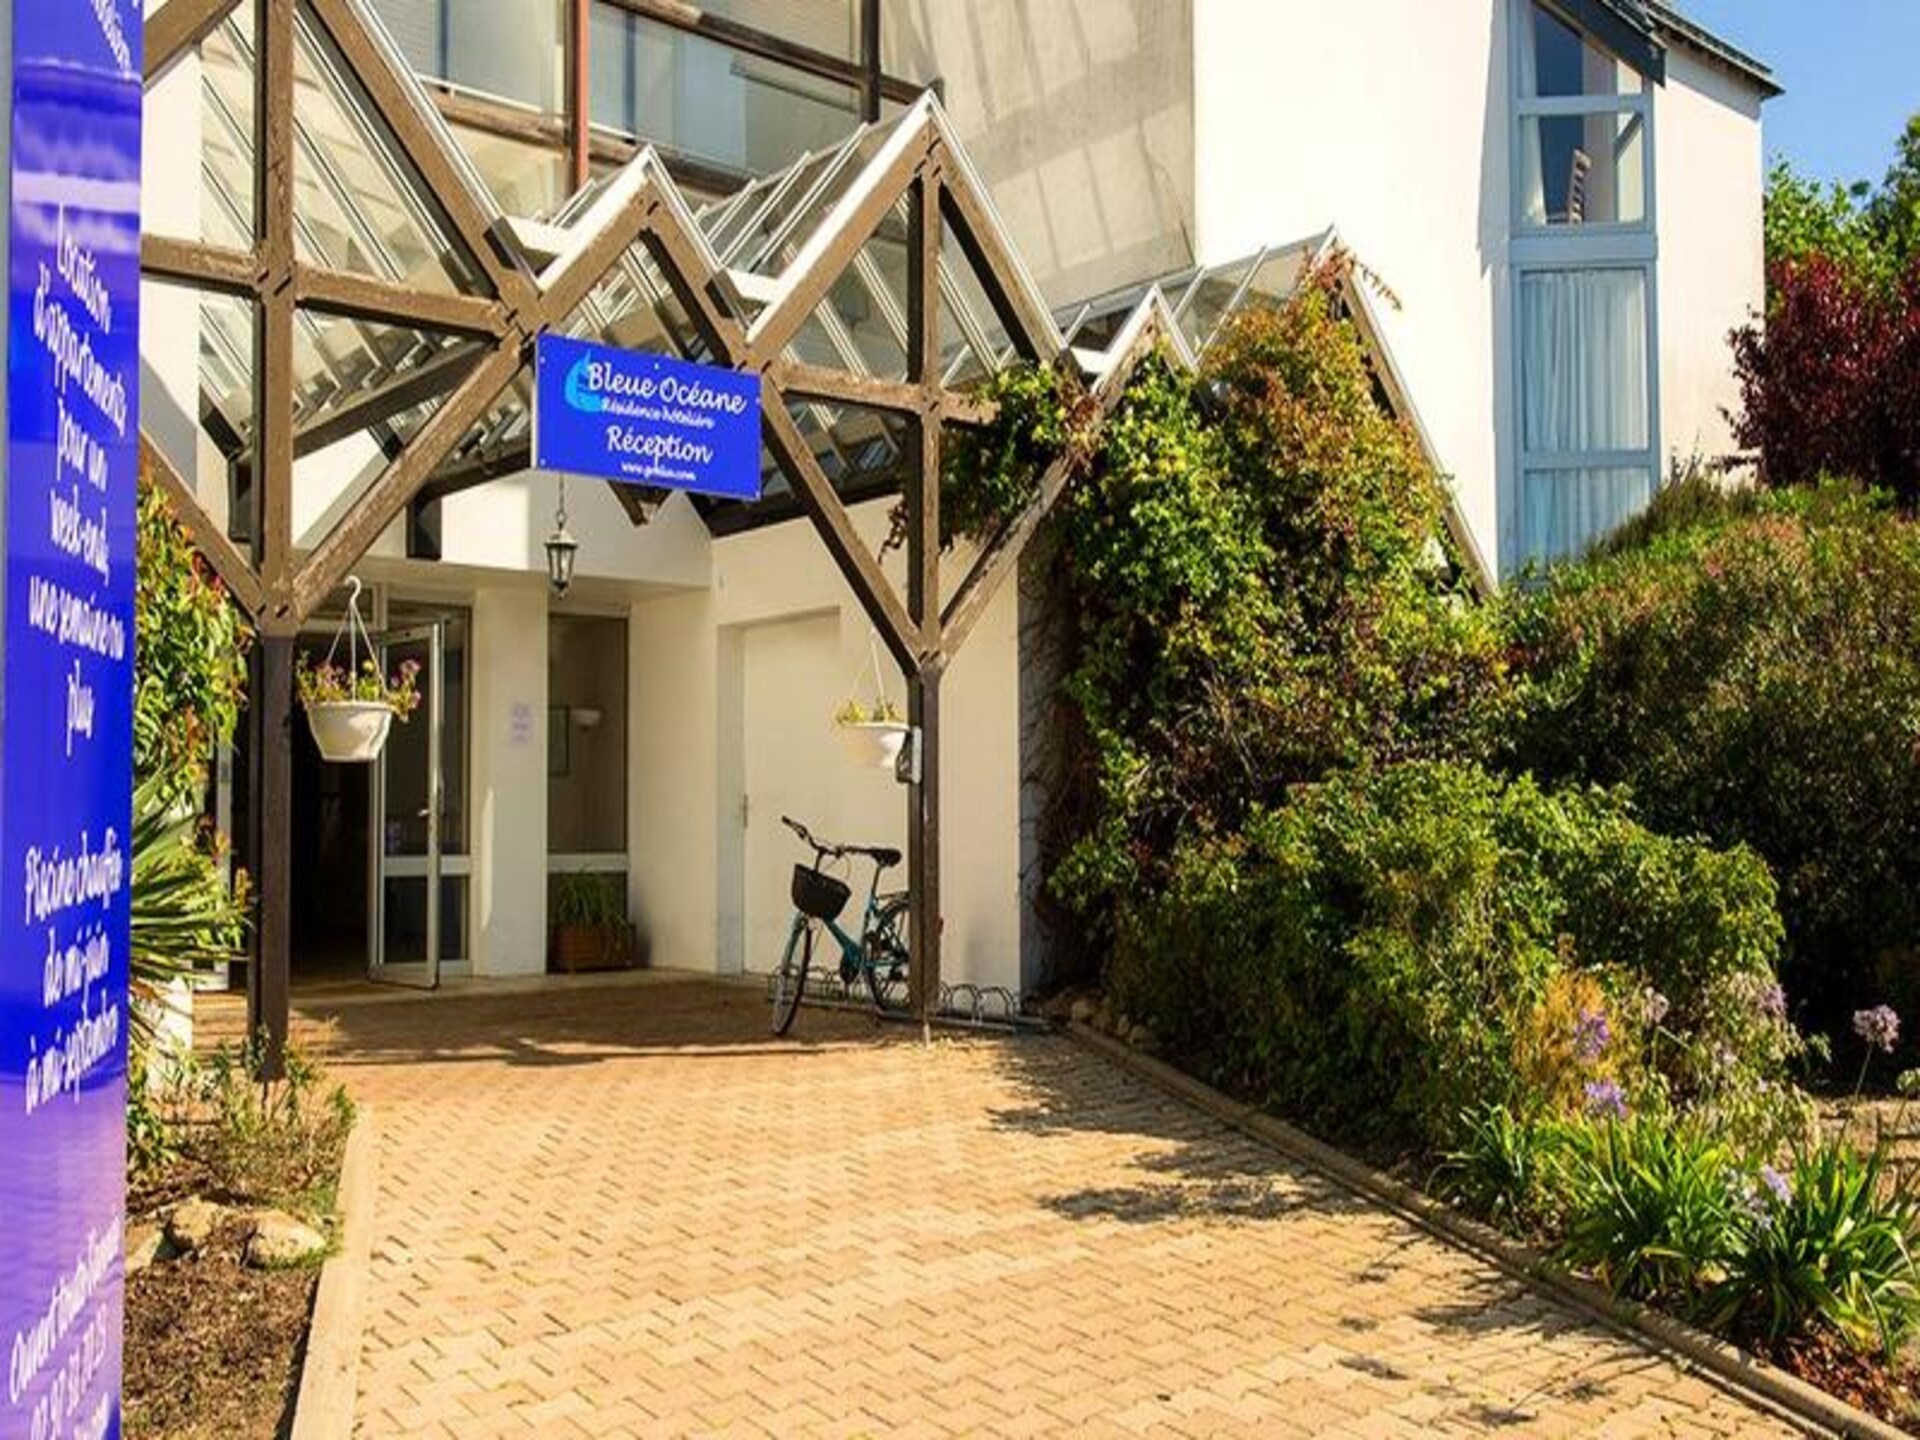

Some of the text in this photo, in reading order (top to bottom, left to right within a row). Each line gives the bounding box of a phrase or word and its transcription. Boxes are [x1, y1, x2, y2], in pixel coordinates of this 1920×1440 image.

[57, 202, 111, 334] Location
[587, 361, 748, 415] Bleue Océane
[57, 397, 109, 492] pour un
[606, 424, 714, 468] Réception
